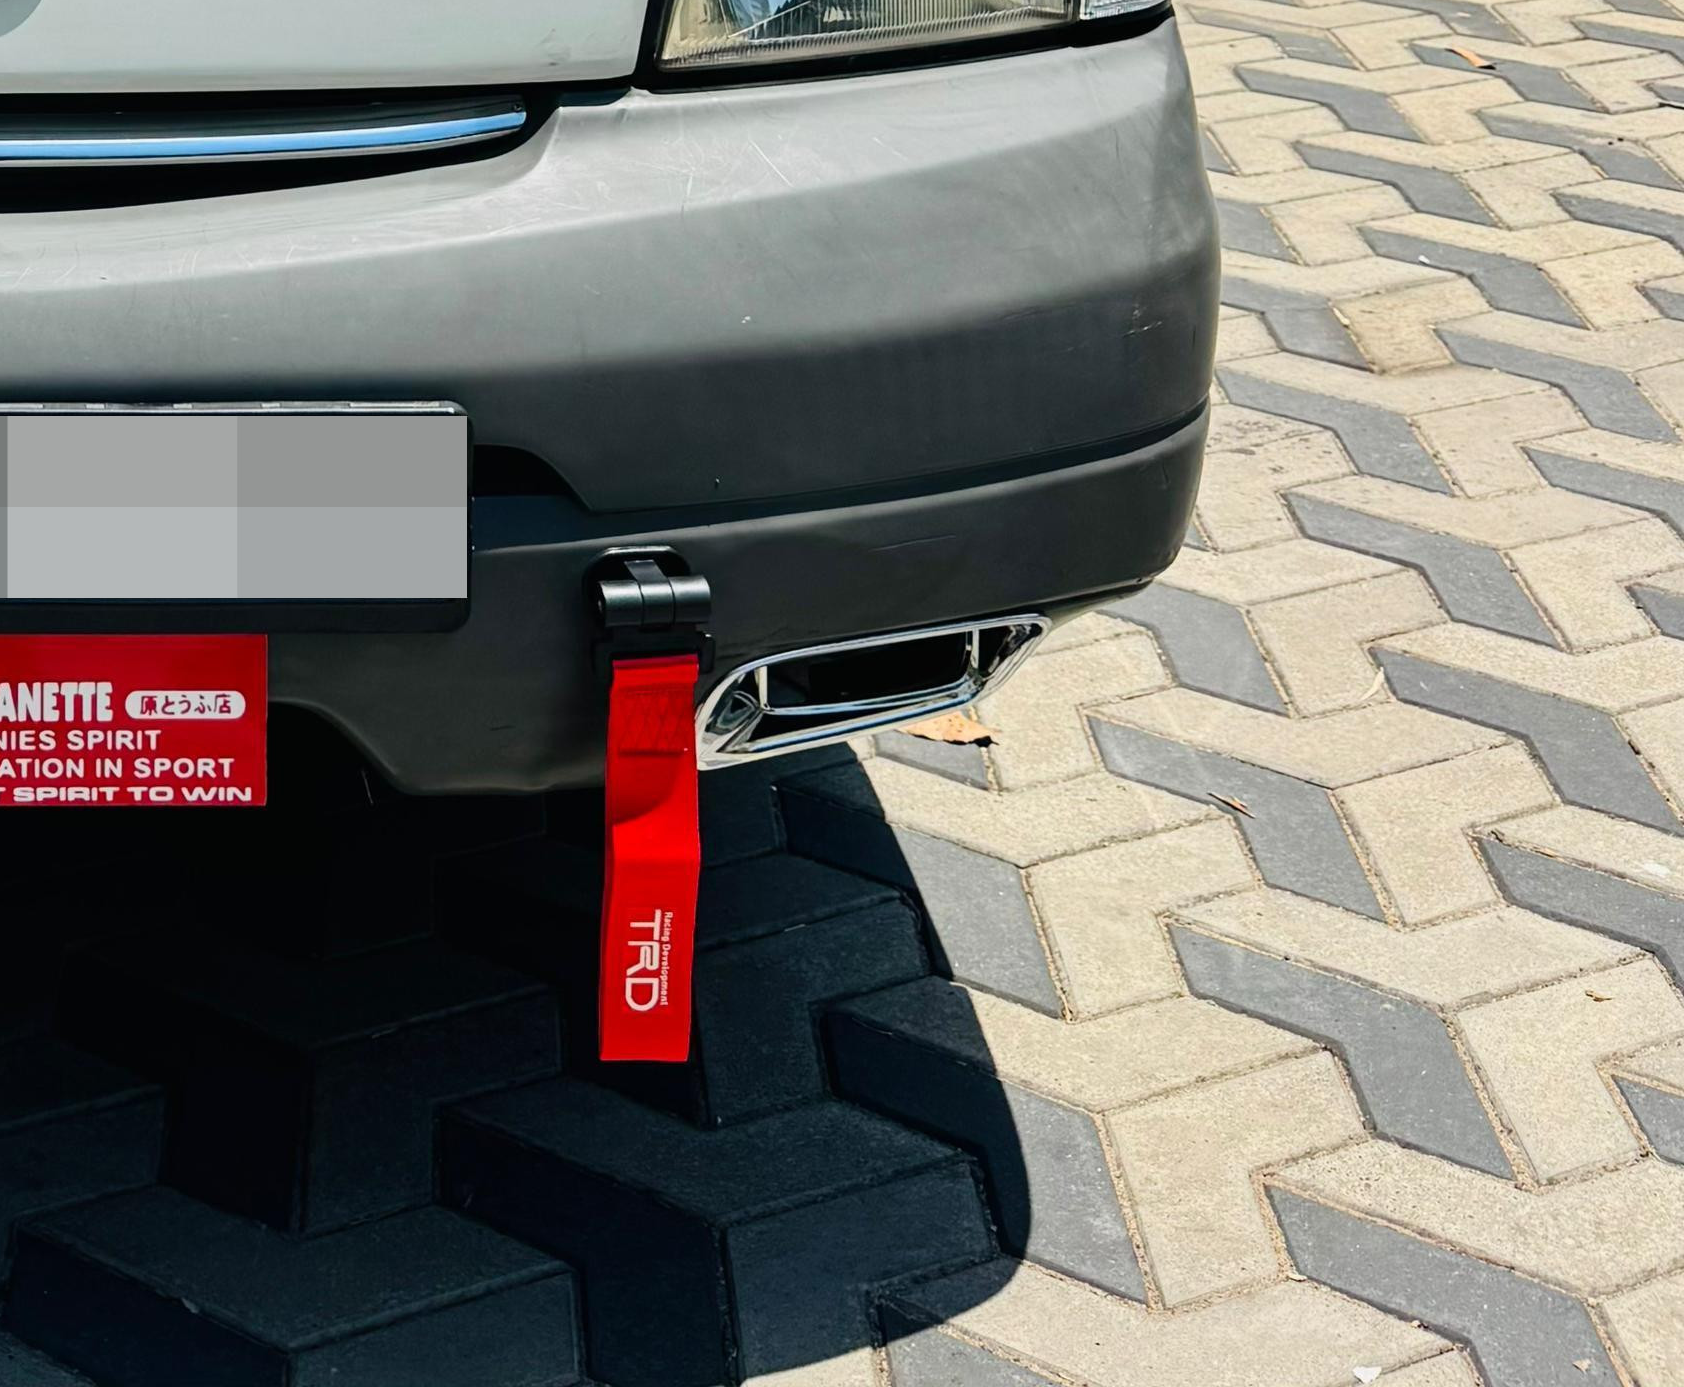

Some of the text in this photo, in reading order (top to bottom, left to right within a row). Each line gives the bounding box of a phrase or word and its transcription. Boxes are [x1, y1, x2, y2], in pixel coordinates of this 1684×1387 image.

[67, 730, 162, 751] SPIRIT
[96, 758, 123, 778] IN
[134, 758, 235, 779] SPORT
[13, 786, 120, 803] SPIRIT
[127, 786, 174, 802] TO
[181, 786, 253, 802] WIN
[625, 909, 662, 1012] TRD
[659, 911, 674, 1006] Racing Development
